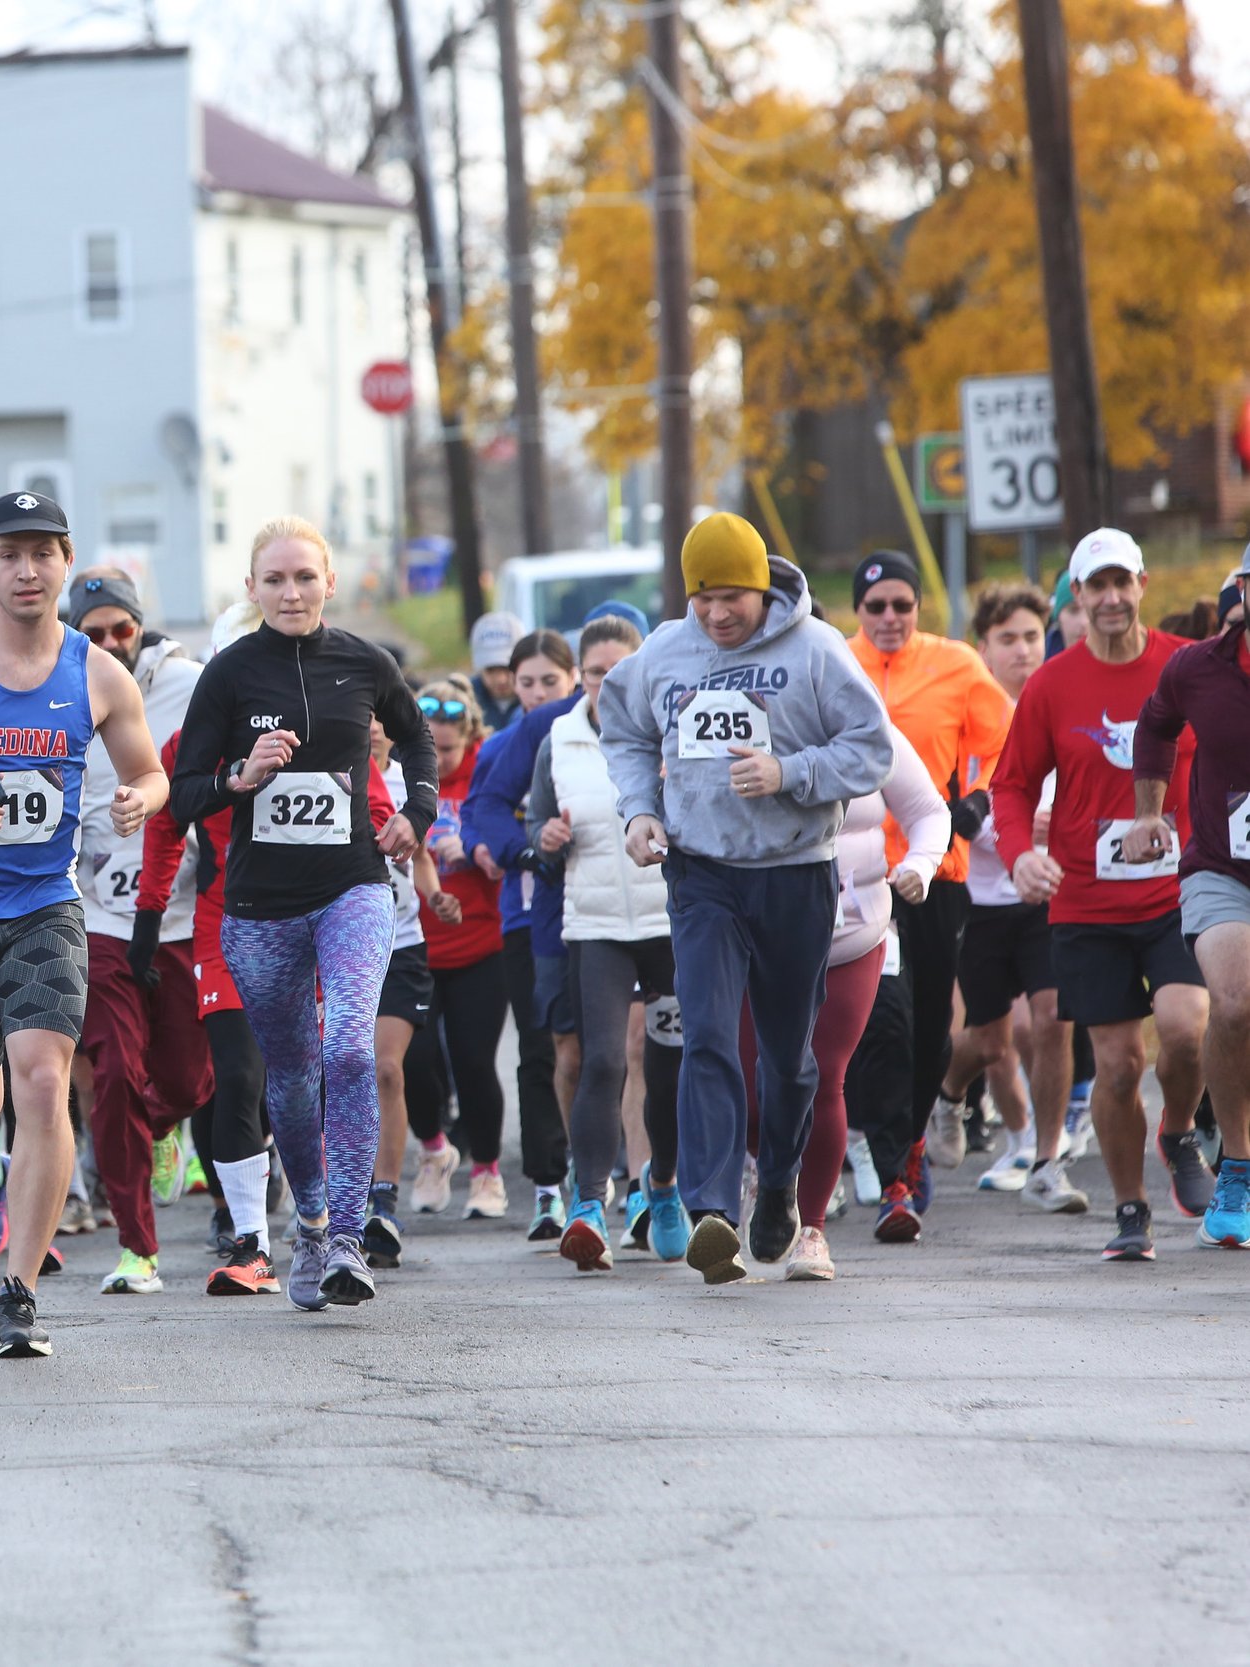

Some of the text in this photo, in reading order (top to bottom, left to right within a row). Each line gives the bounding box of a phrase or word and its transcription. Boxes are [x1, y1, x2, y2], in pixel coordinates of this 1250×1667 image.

[989, 455, 1062, 511] 30
[694, 711, 753, 741] 235
[270, 793, 335, 826] 322
